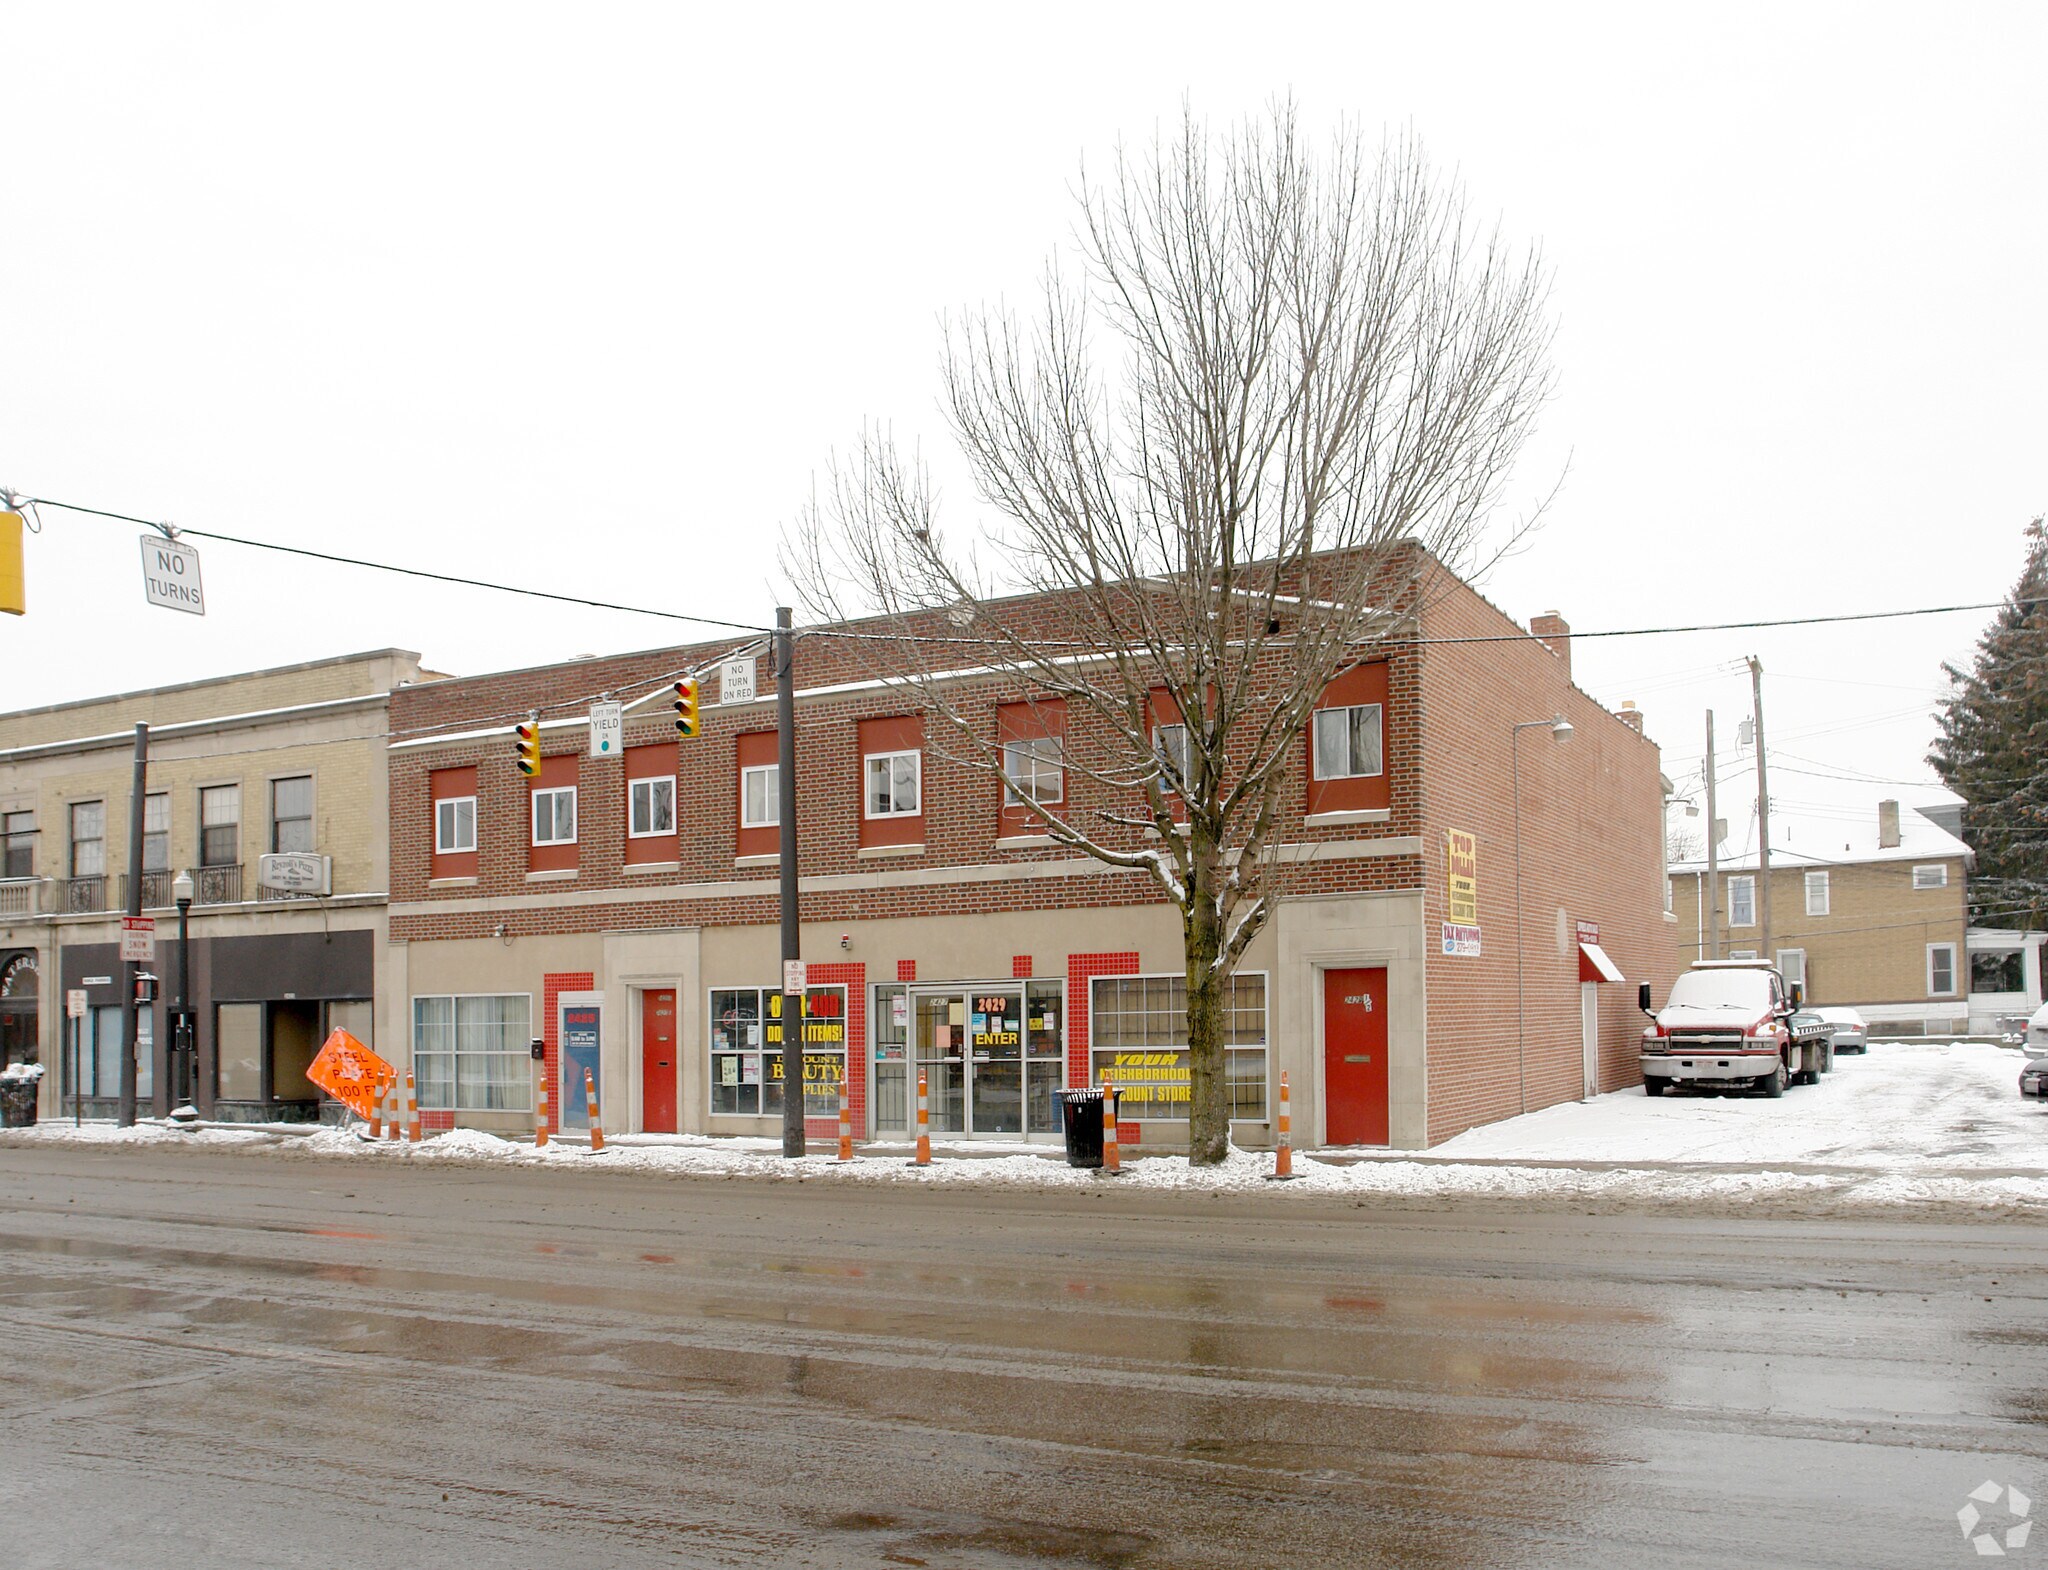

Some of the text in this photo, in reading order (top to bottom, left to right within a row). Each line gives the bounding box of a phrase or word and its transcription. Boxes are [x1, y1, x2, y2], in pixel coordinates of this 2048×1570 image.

[158, 550, 184, 575] NO
[148, 577, 200, 604] TURNS
[731, 665, 743, 674] NO
[728, 677, 748, 687] TURN
[724, 688, 752, 700] ON RED
[593, 718, 619, 730] YIELD
[1452, 834, 1472, 856] TOP
[298, 860, 313, 875] Pizza
[131, 920, 154, 929] STOPPING
[1443, 925, 1454, 940] TAX
[128, 940, 147, 948] SNOW
[810, 994, 839, 1017] 400
[977, 997, 1007, 1012] 2429
[567, 1013, 596, 1024] 2425
[807, 1024, 843, 1043] ITEMS!
[975, 1032, 1018, 1045] ENTER
[328, 1052, 369, 1064] STEEL
[1114, 1054, 1179, 1066] YOUR
[338, 1085, 360, 1097] 100
[1157, 1085, 1192, 1102] STORE
